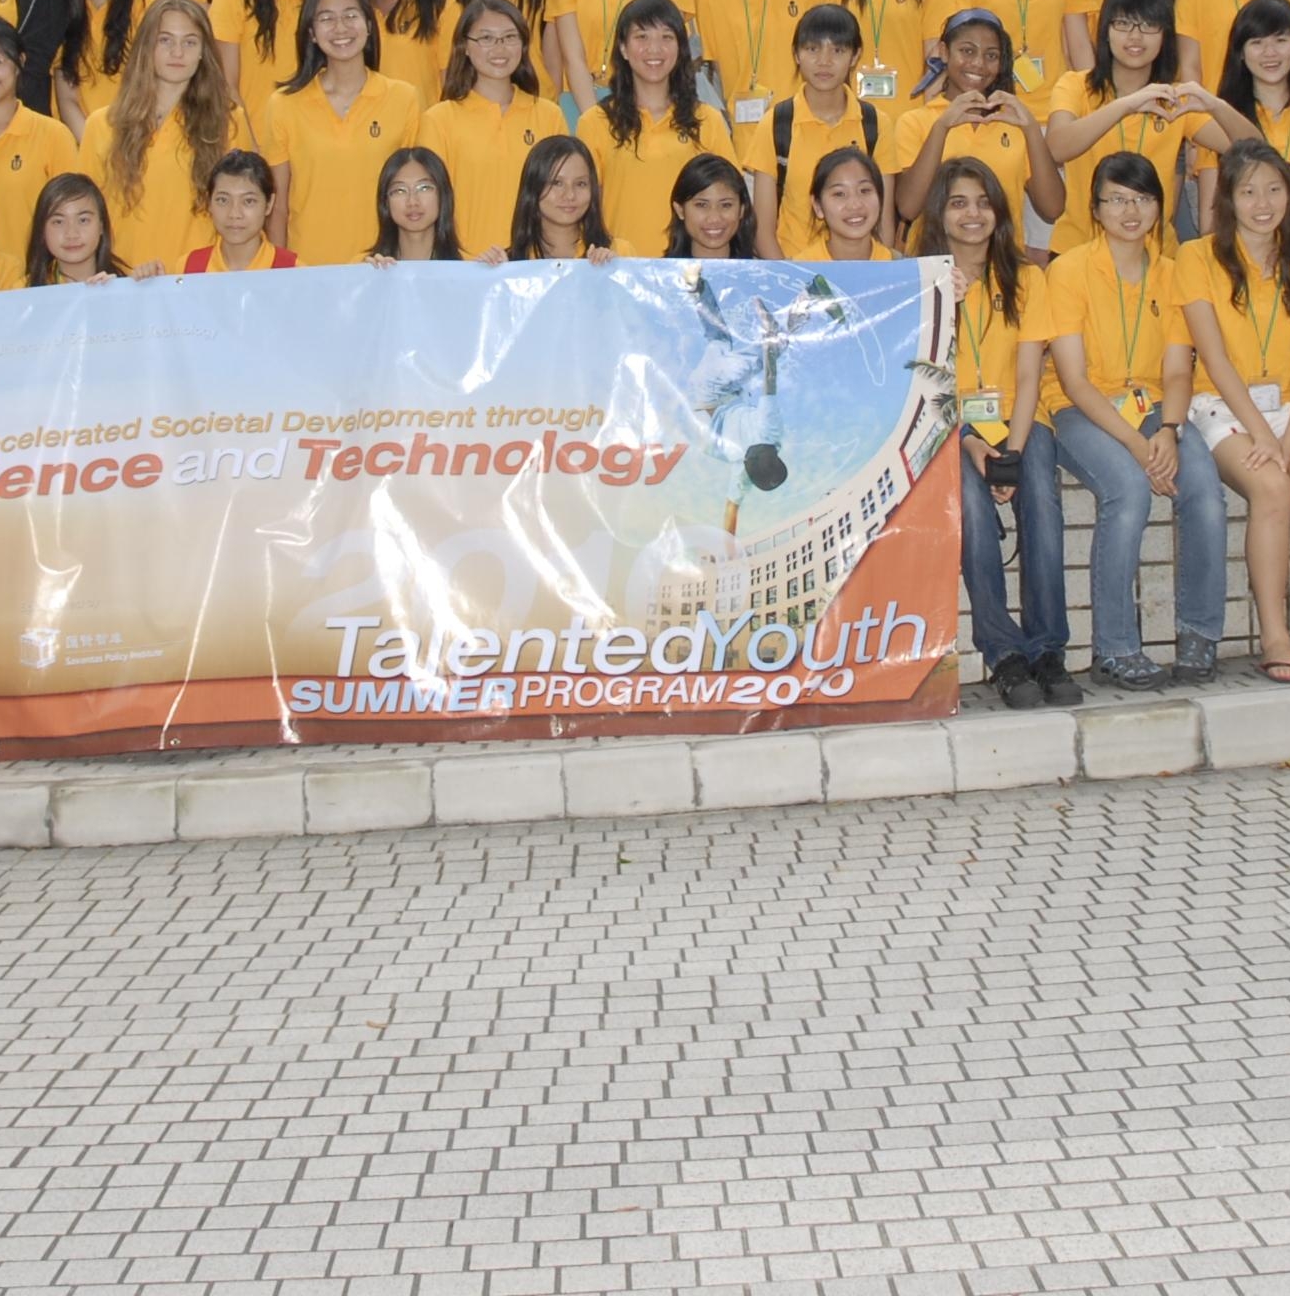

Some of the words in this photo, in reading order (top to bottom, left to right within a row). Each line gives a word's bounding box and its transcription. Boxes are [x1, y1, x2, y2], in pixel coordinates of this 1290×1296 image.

[150, 411, 273, 439] Societal
[281, 406, 476, 433] Development
[485, 404, 605, 432] through
[172, 437, 290, 486] and
[298, 430, 689, 487] Technology
[105, 652, 128, 664] Policy
[289, 678, 518, 713] SUMMER
[519, 674, 728, 708] PROGRAM
